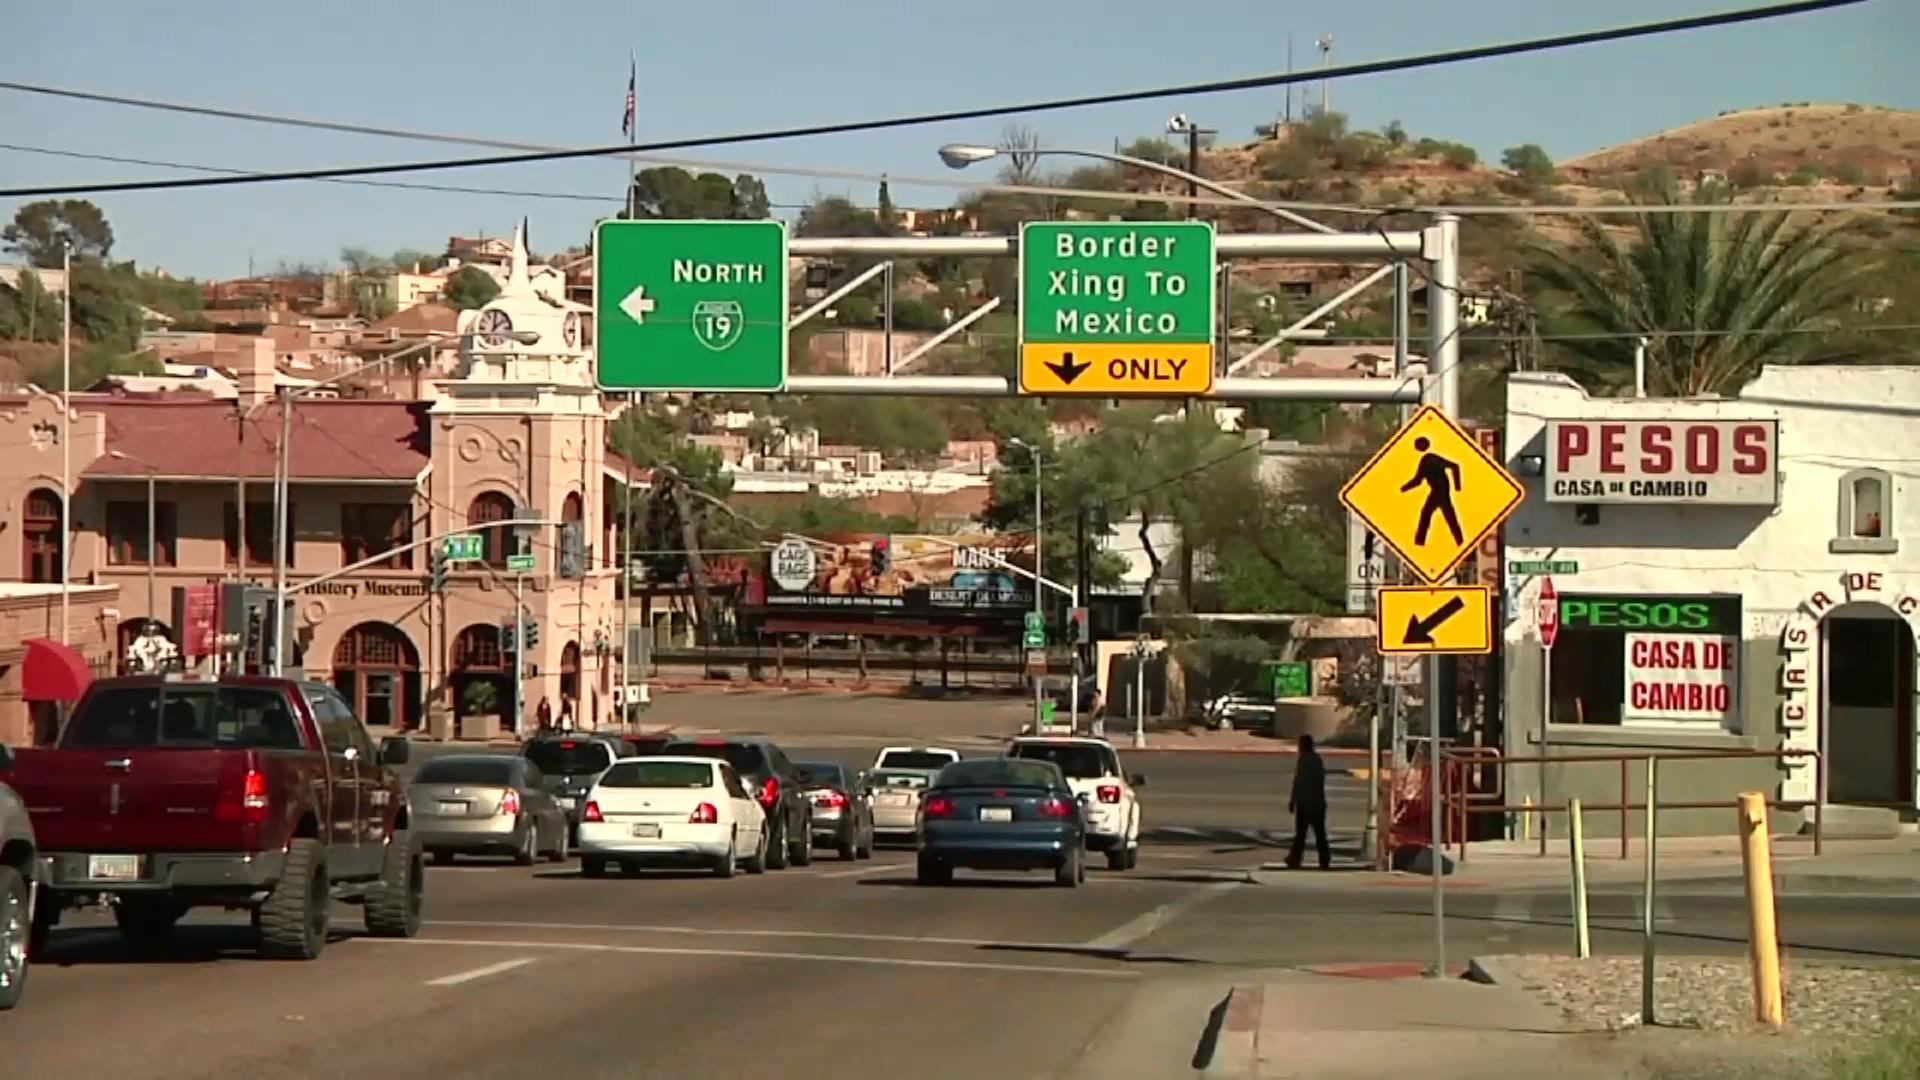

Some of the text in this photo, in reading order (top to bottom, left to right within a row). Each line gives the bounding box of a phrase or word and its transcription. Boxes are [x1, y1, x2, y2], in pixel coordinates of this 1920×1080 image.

[1056, 230, 1177, 258] Border
[1048, 269, 1186, 303] Xing To
[705, 316, 731, 340] 19
[1055, 307, 1176, 335] Mexico
[1108, 358, 1188, 380] ONLY
[1557, 424, 1767, 474] PESOS
[1554, 479, 1708, 497] CASA DE CAMBIO
[1849, 572, 1884, 592] DE
[1560, 601, 1711, 629] PESOS
[1631, 640, 1733, 671] CASA DE
[1631, 681, 1731, 713] CAMBIO
